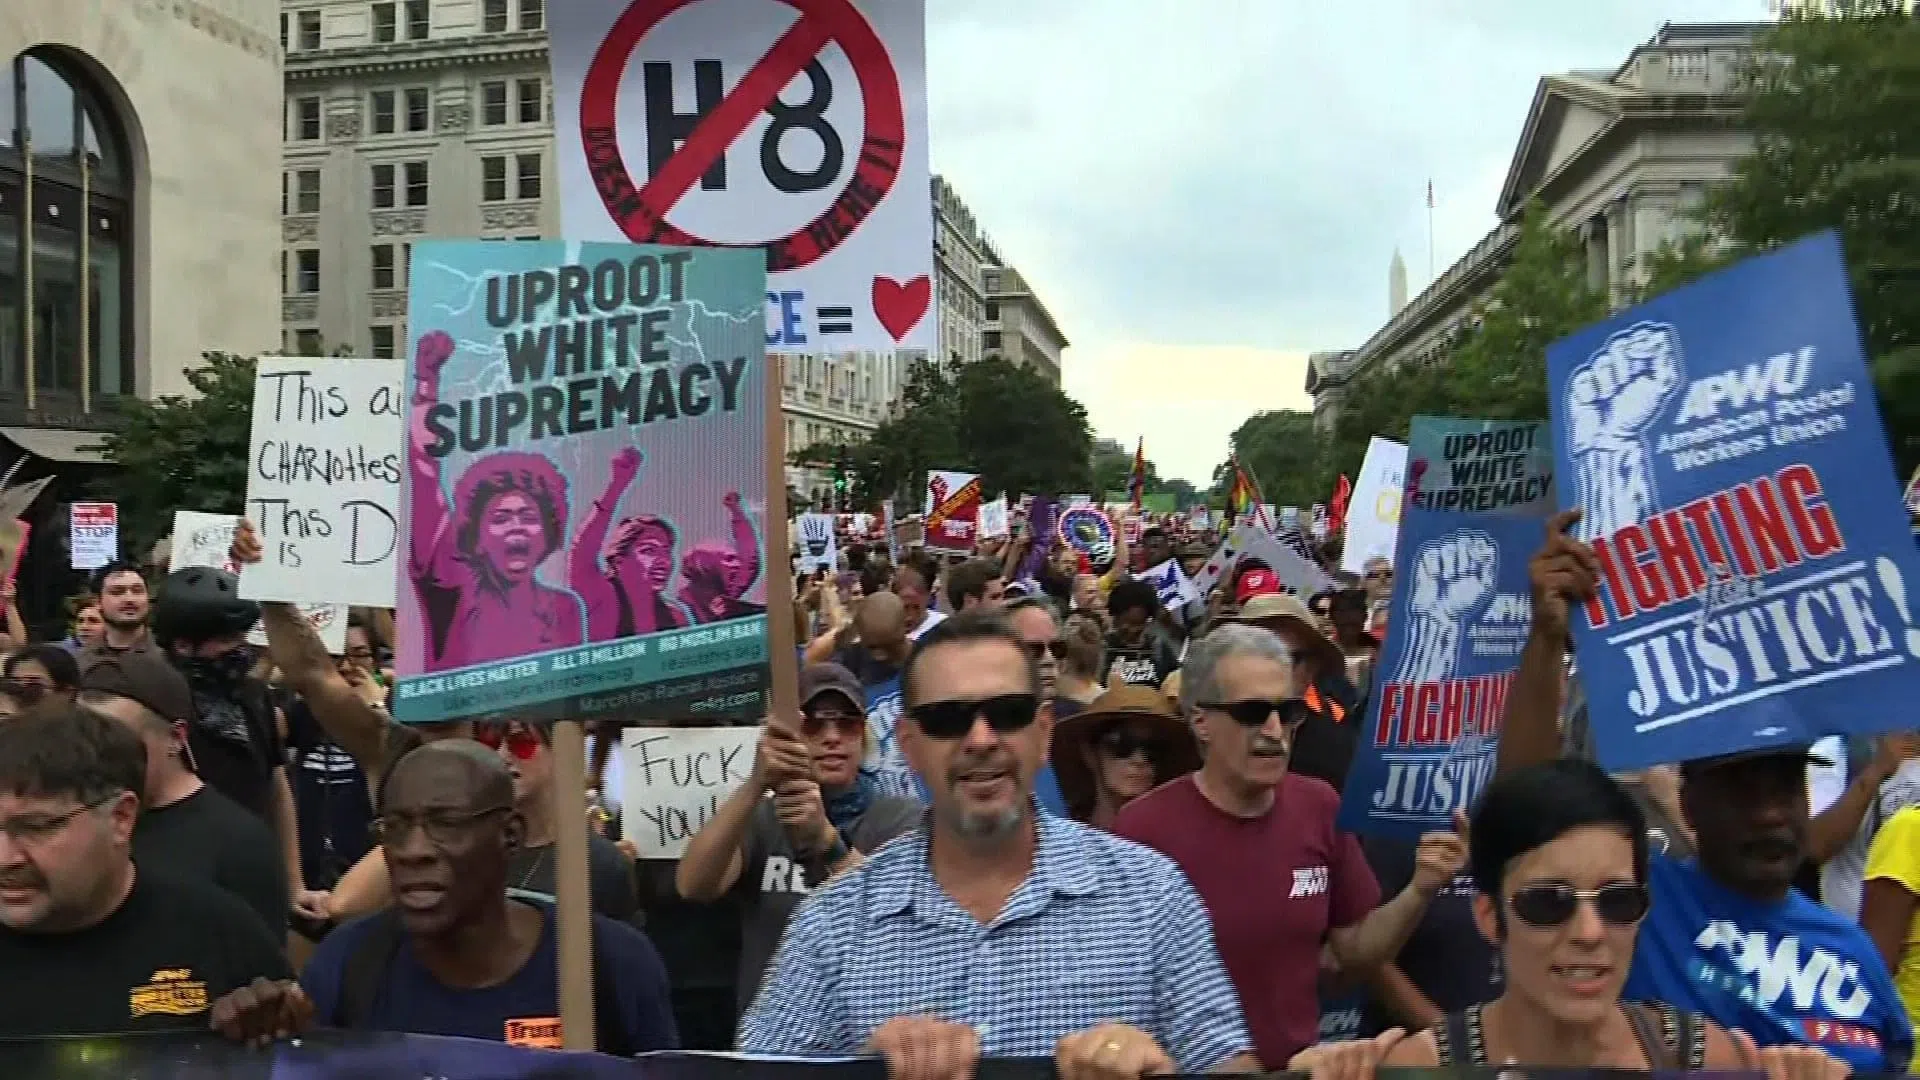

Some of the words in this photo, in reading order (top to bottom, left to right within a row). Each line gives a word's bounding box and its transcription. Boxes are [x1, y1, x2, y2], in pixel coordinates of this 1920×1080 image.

[485, 251, 692, 328] UPROOT
[504, 309, 672, 383] WHITE
[260, 371, 349, 424] This
[424, 357, 747, 458] SUPREMACY
[1656, 409, 1770, 454] American
[1775, 381, 1856, 422] Postal
[1674, 346, 1816, 425] APWU
[1443, 424, 1539, 461] UPROOT
[1451, 456, 1528, 486] WHITE
[1672, 435, 1768, 473] Workers
[1771, 414, 1847, 447] Union
[248, 498, 332, 538] This
[1411, 472, 1553, 513] SUPREMACY
[74, 527, 113, 538] STOP
[400, 679, 445, 699] BLACK
[447, 670, 486, 690] LIVES
[487, 660, 540, 684] MATTER
[551, 652, 578, 671] ALL
[591, 641, 648, 665] MILLION
[680, 627, 732, 648] MUSLIM
[734, 620, 761, 638] BAN
[1373, 665, 1521, 745] FIGHTIN
